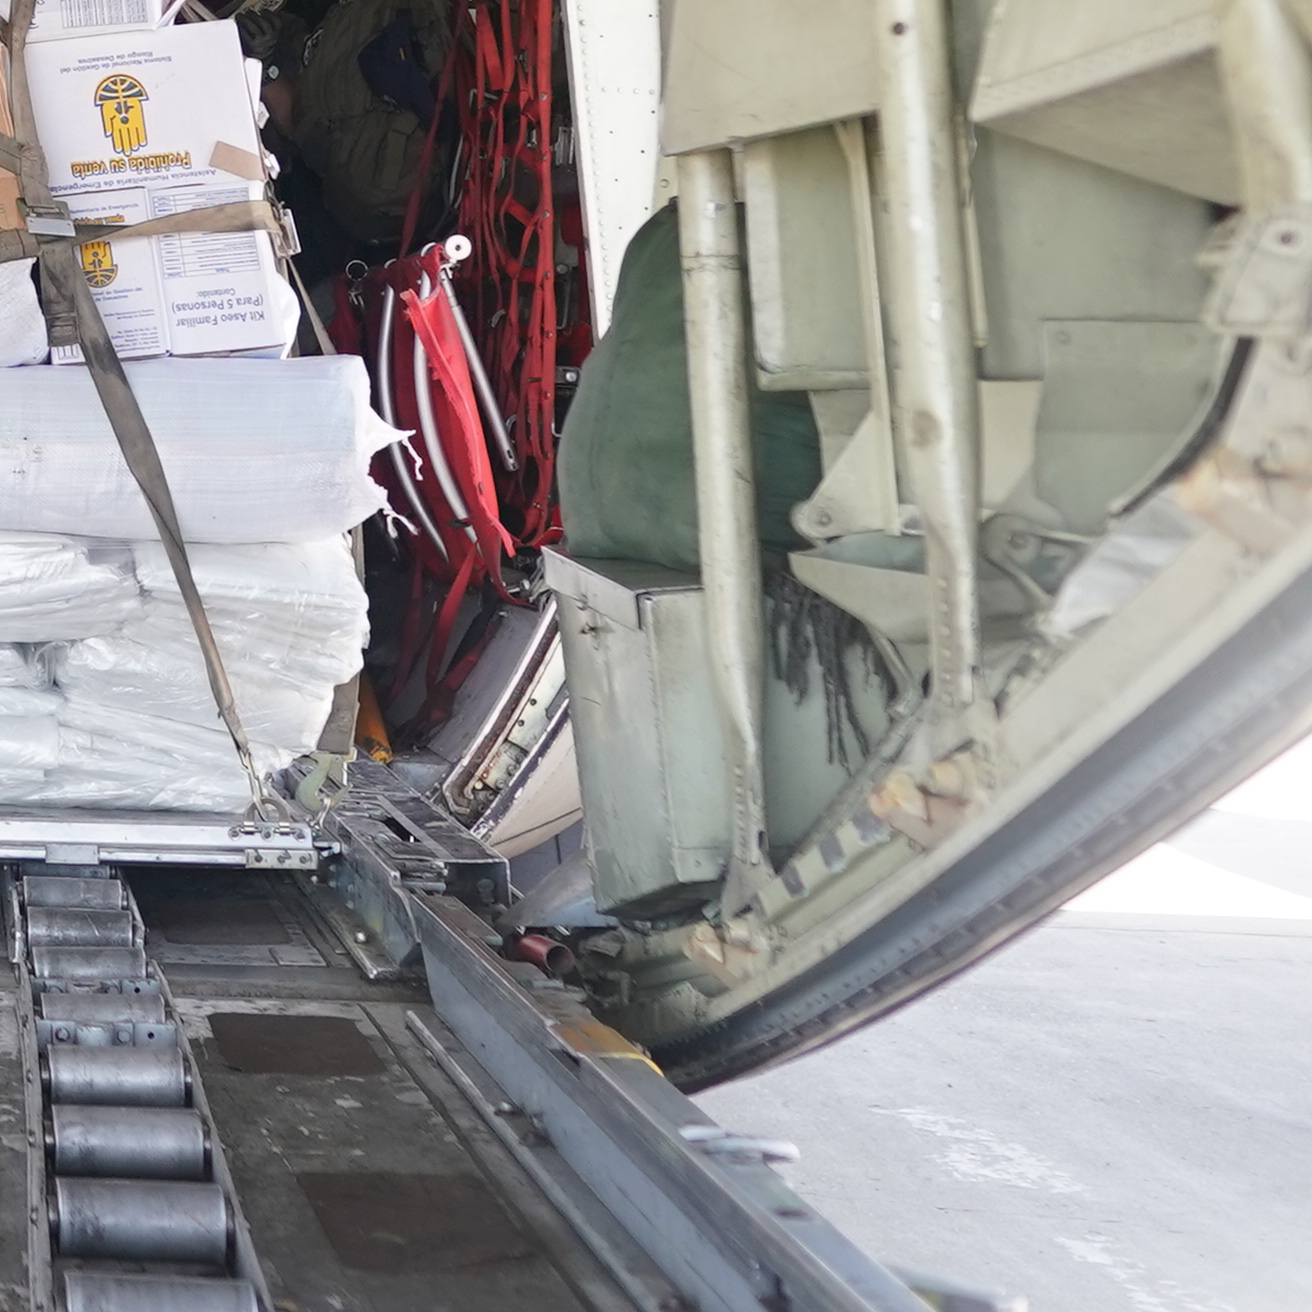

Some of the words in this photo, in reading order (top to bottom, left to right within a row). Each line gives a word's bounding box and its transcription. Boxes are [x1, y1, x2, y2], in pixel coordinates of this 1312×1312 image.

[111, 58, 142, 68] Nacional
[60, 67, 71, 75] del
[109, 157, 127, 174] su
[128, 151, 193, 175] Prohibida
[71, 161, 110, 180] venta
[171, 165, 212, 180] Asistencia
[103, 179, 115, 187] de
[117, 172, 170, 186] Humanitaria
[50, 181, 102, 194] Emergencia
[196, 287, 236, 298] Contenido:
[226, 298, 234, 309] 5
[235, 293, 264, 307] (Para
[172, 300, 225, 314] Personas)
[220, 312, 248, 323] Aseo
[250, 310, 266, 321] Kit
[176, 316, 218, 328] Familiar
